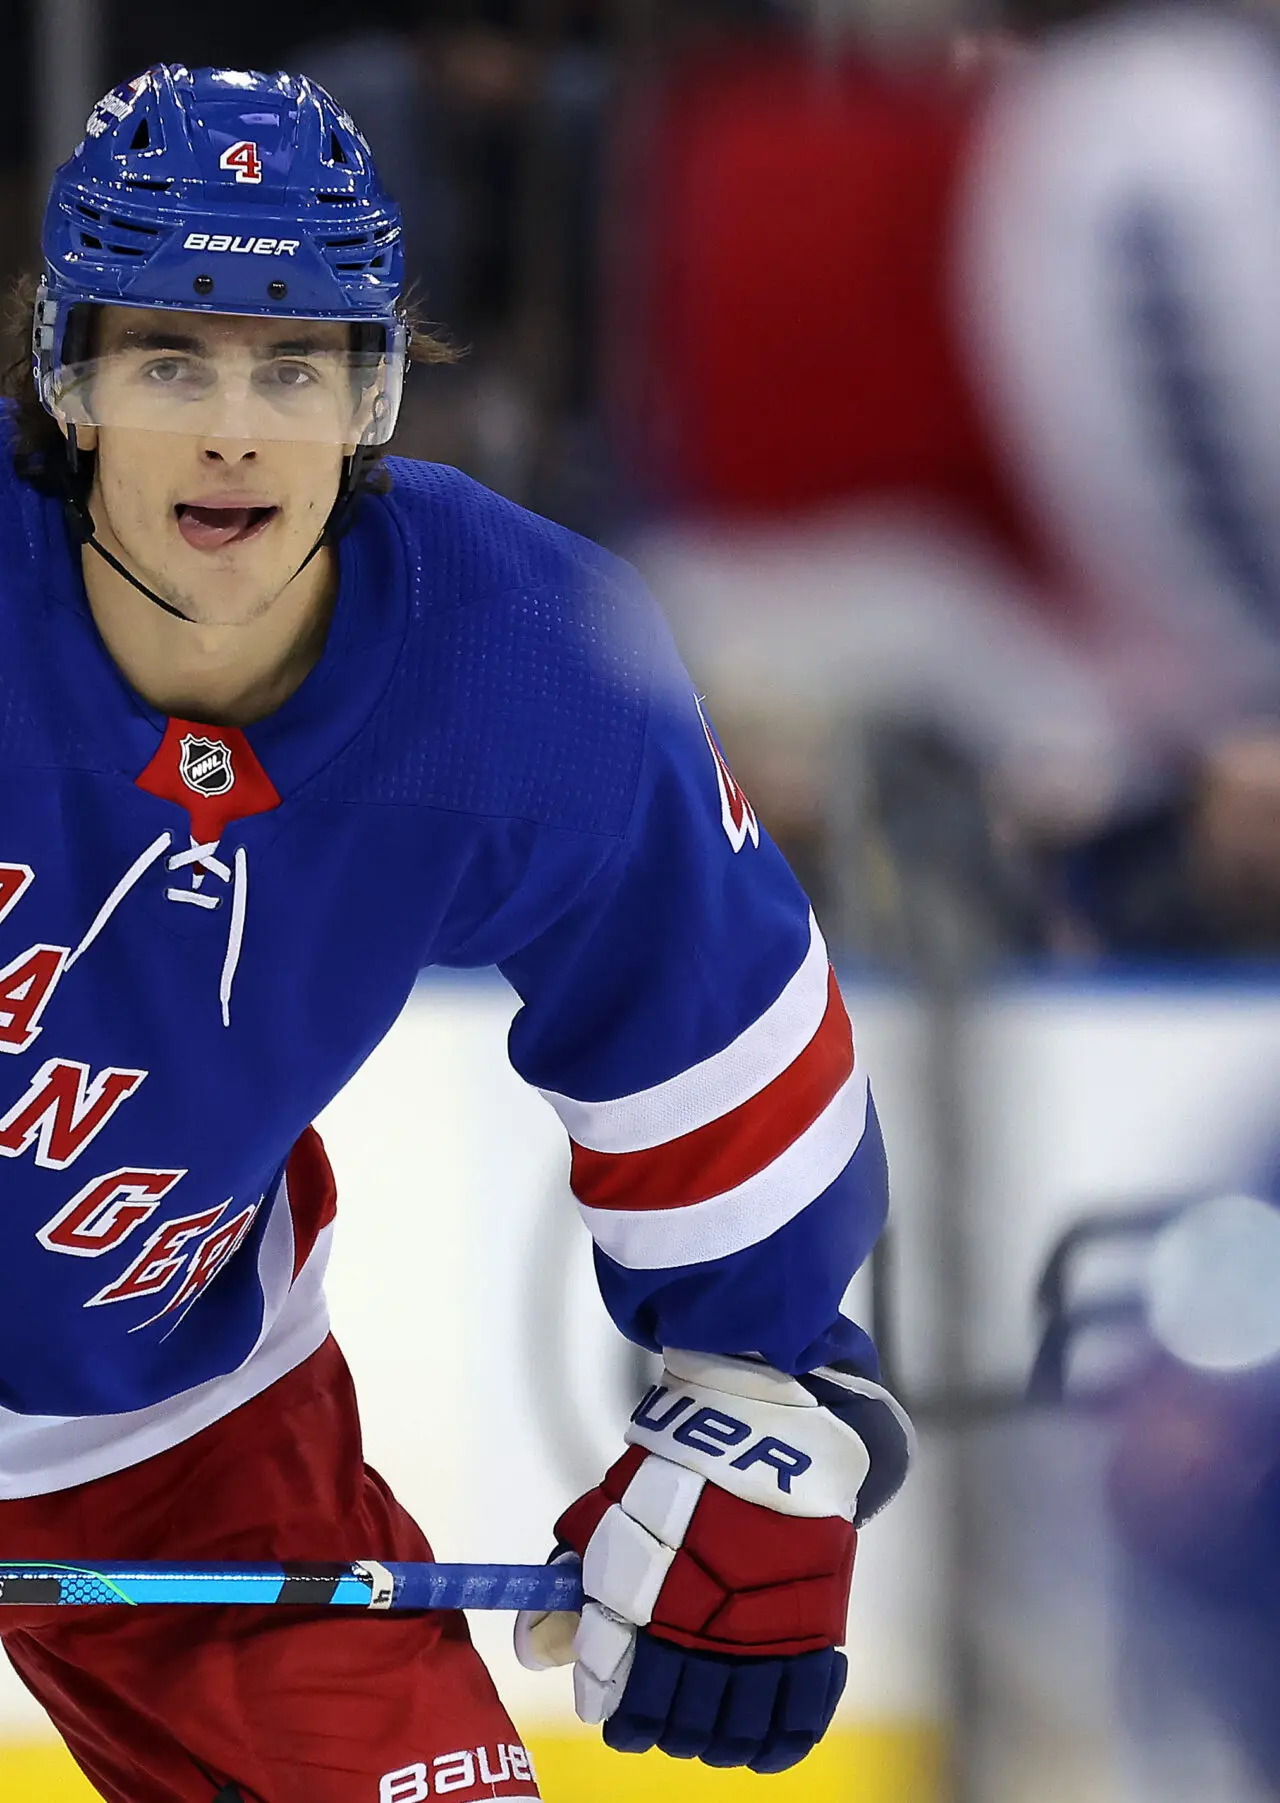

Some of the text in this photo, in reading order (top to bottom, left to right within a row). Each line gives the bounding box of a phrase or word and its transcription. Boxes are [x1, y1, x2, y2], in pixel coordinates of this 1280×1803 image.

[219, 140, 263, 184] 4
[191, 754, 222, 780] NHL
[630, 1384, 813, 1495] UER
[379, 1743, 537, 1803] BAUE
